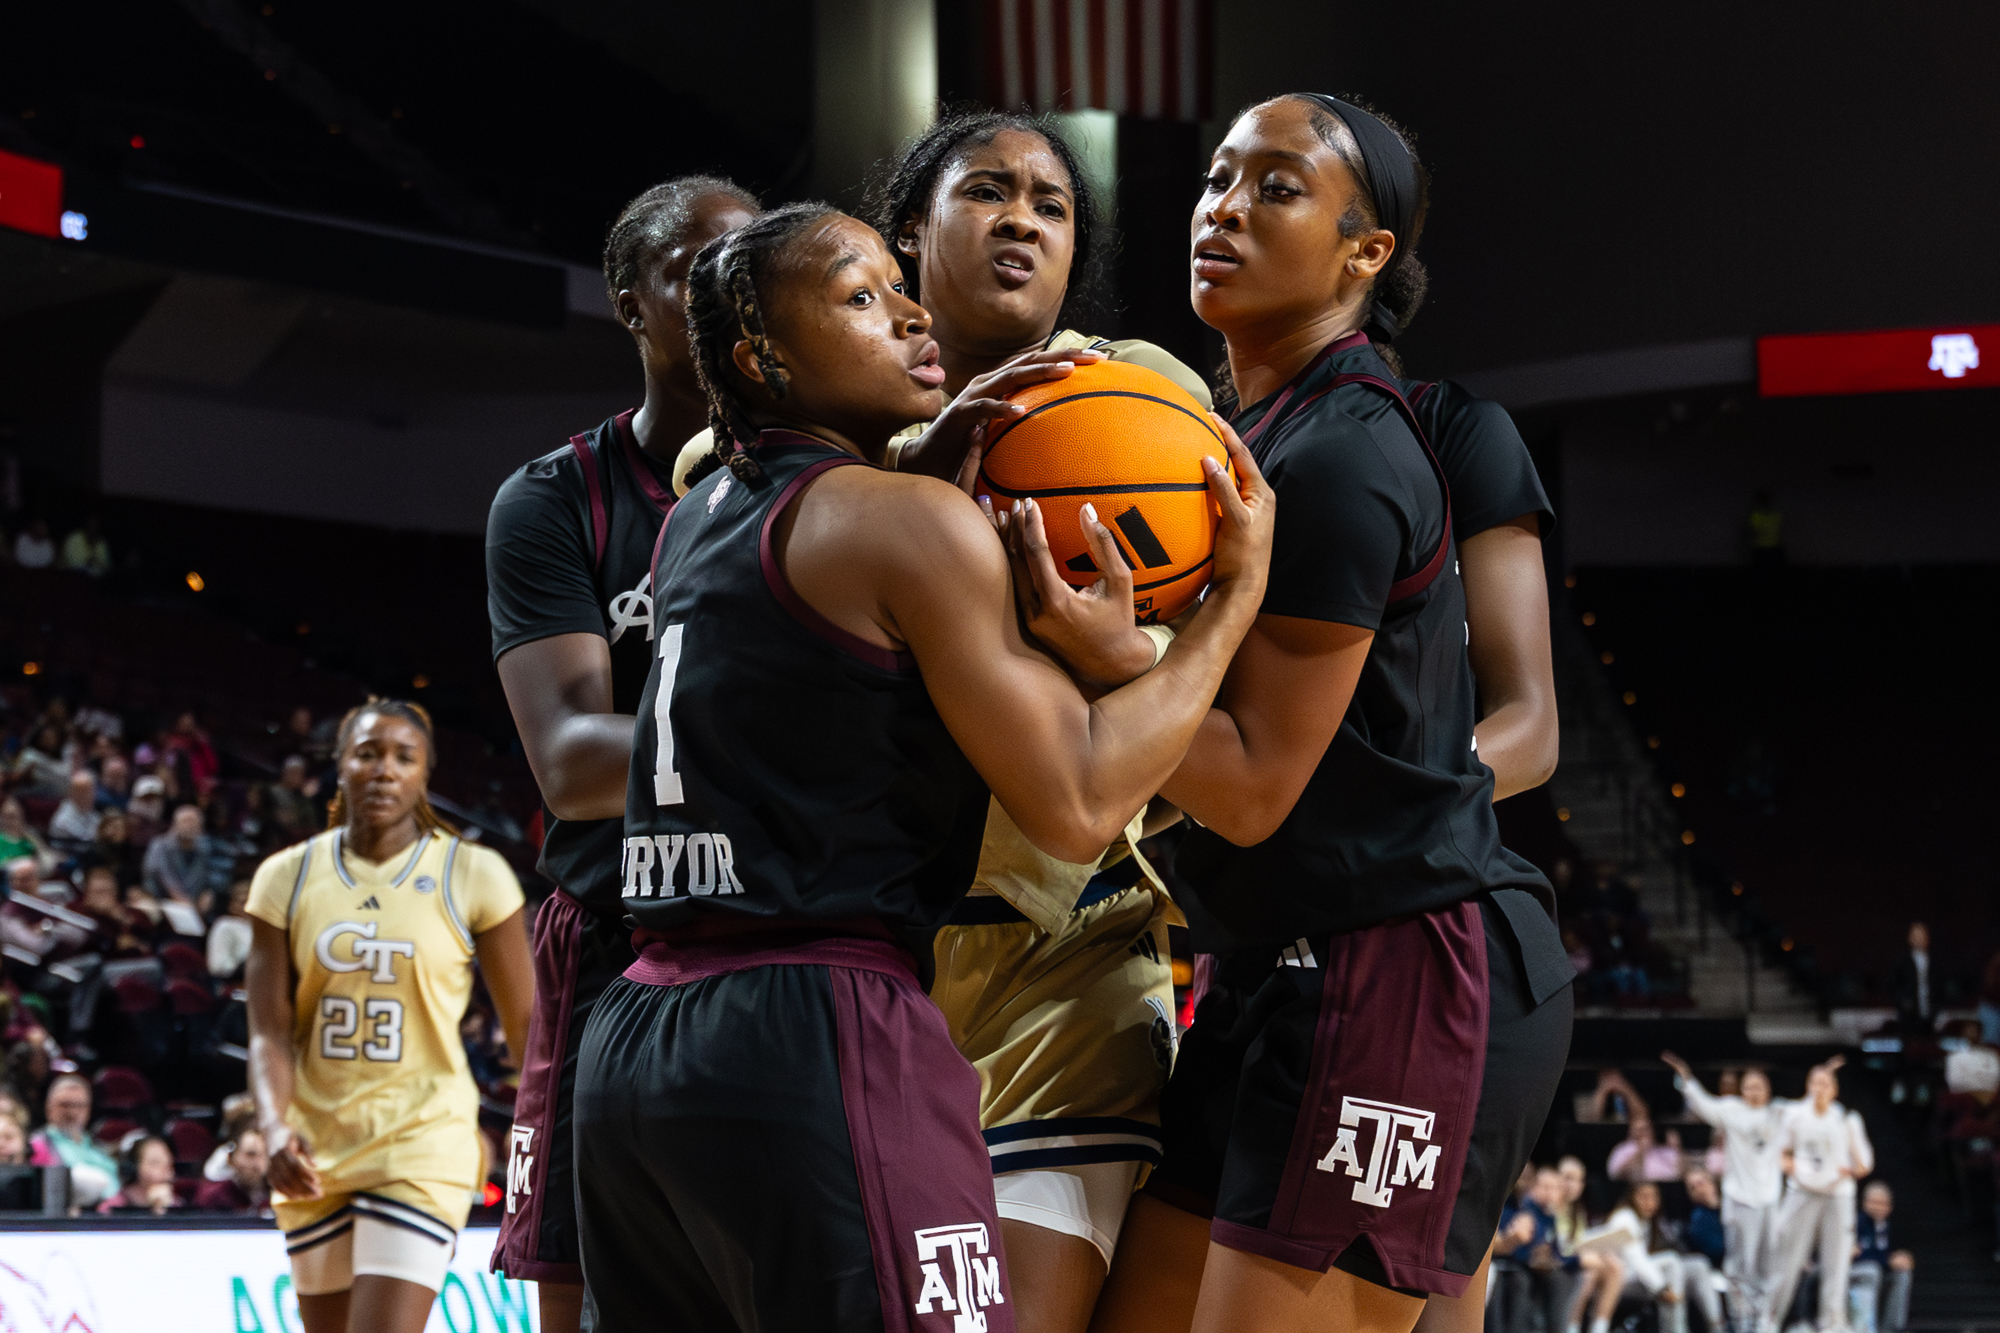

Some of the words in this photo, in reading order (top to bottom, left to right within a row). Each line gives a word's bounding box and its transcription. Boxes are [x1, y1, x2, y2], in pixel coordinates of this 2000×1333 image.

[654, 623, 685, 807] 1
[621, 832, 746, 899] RYOR
[315, 920, 415, 985] GT
[321, 996, 404, 1063] 23
